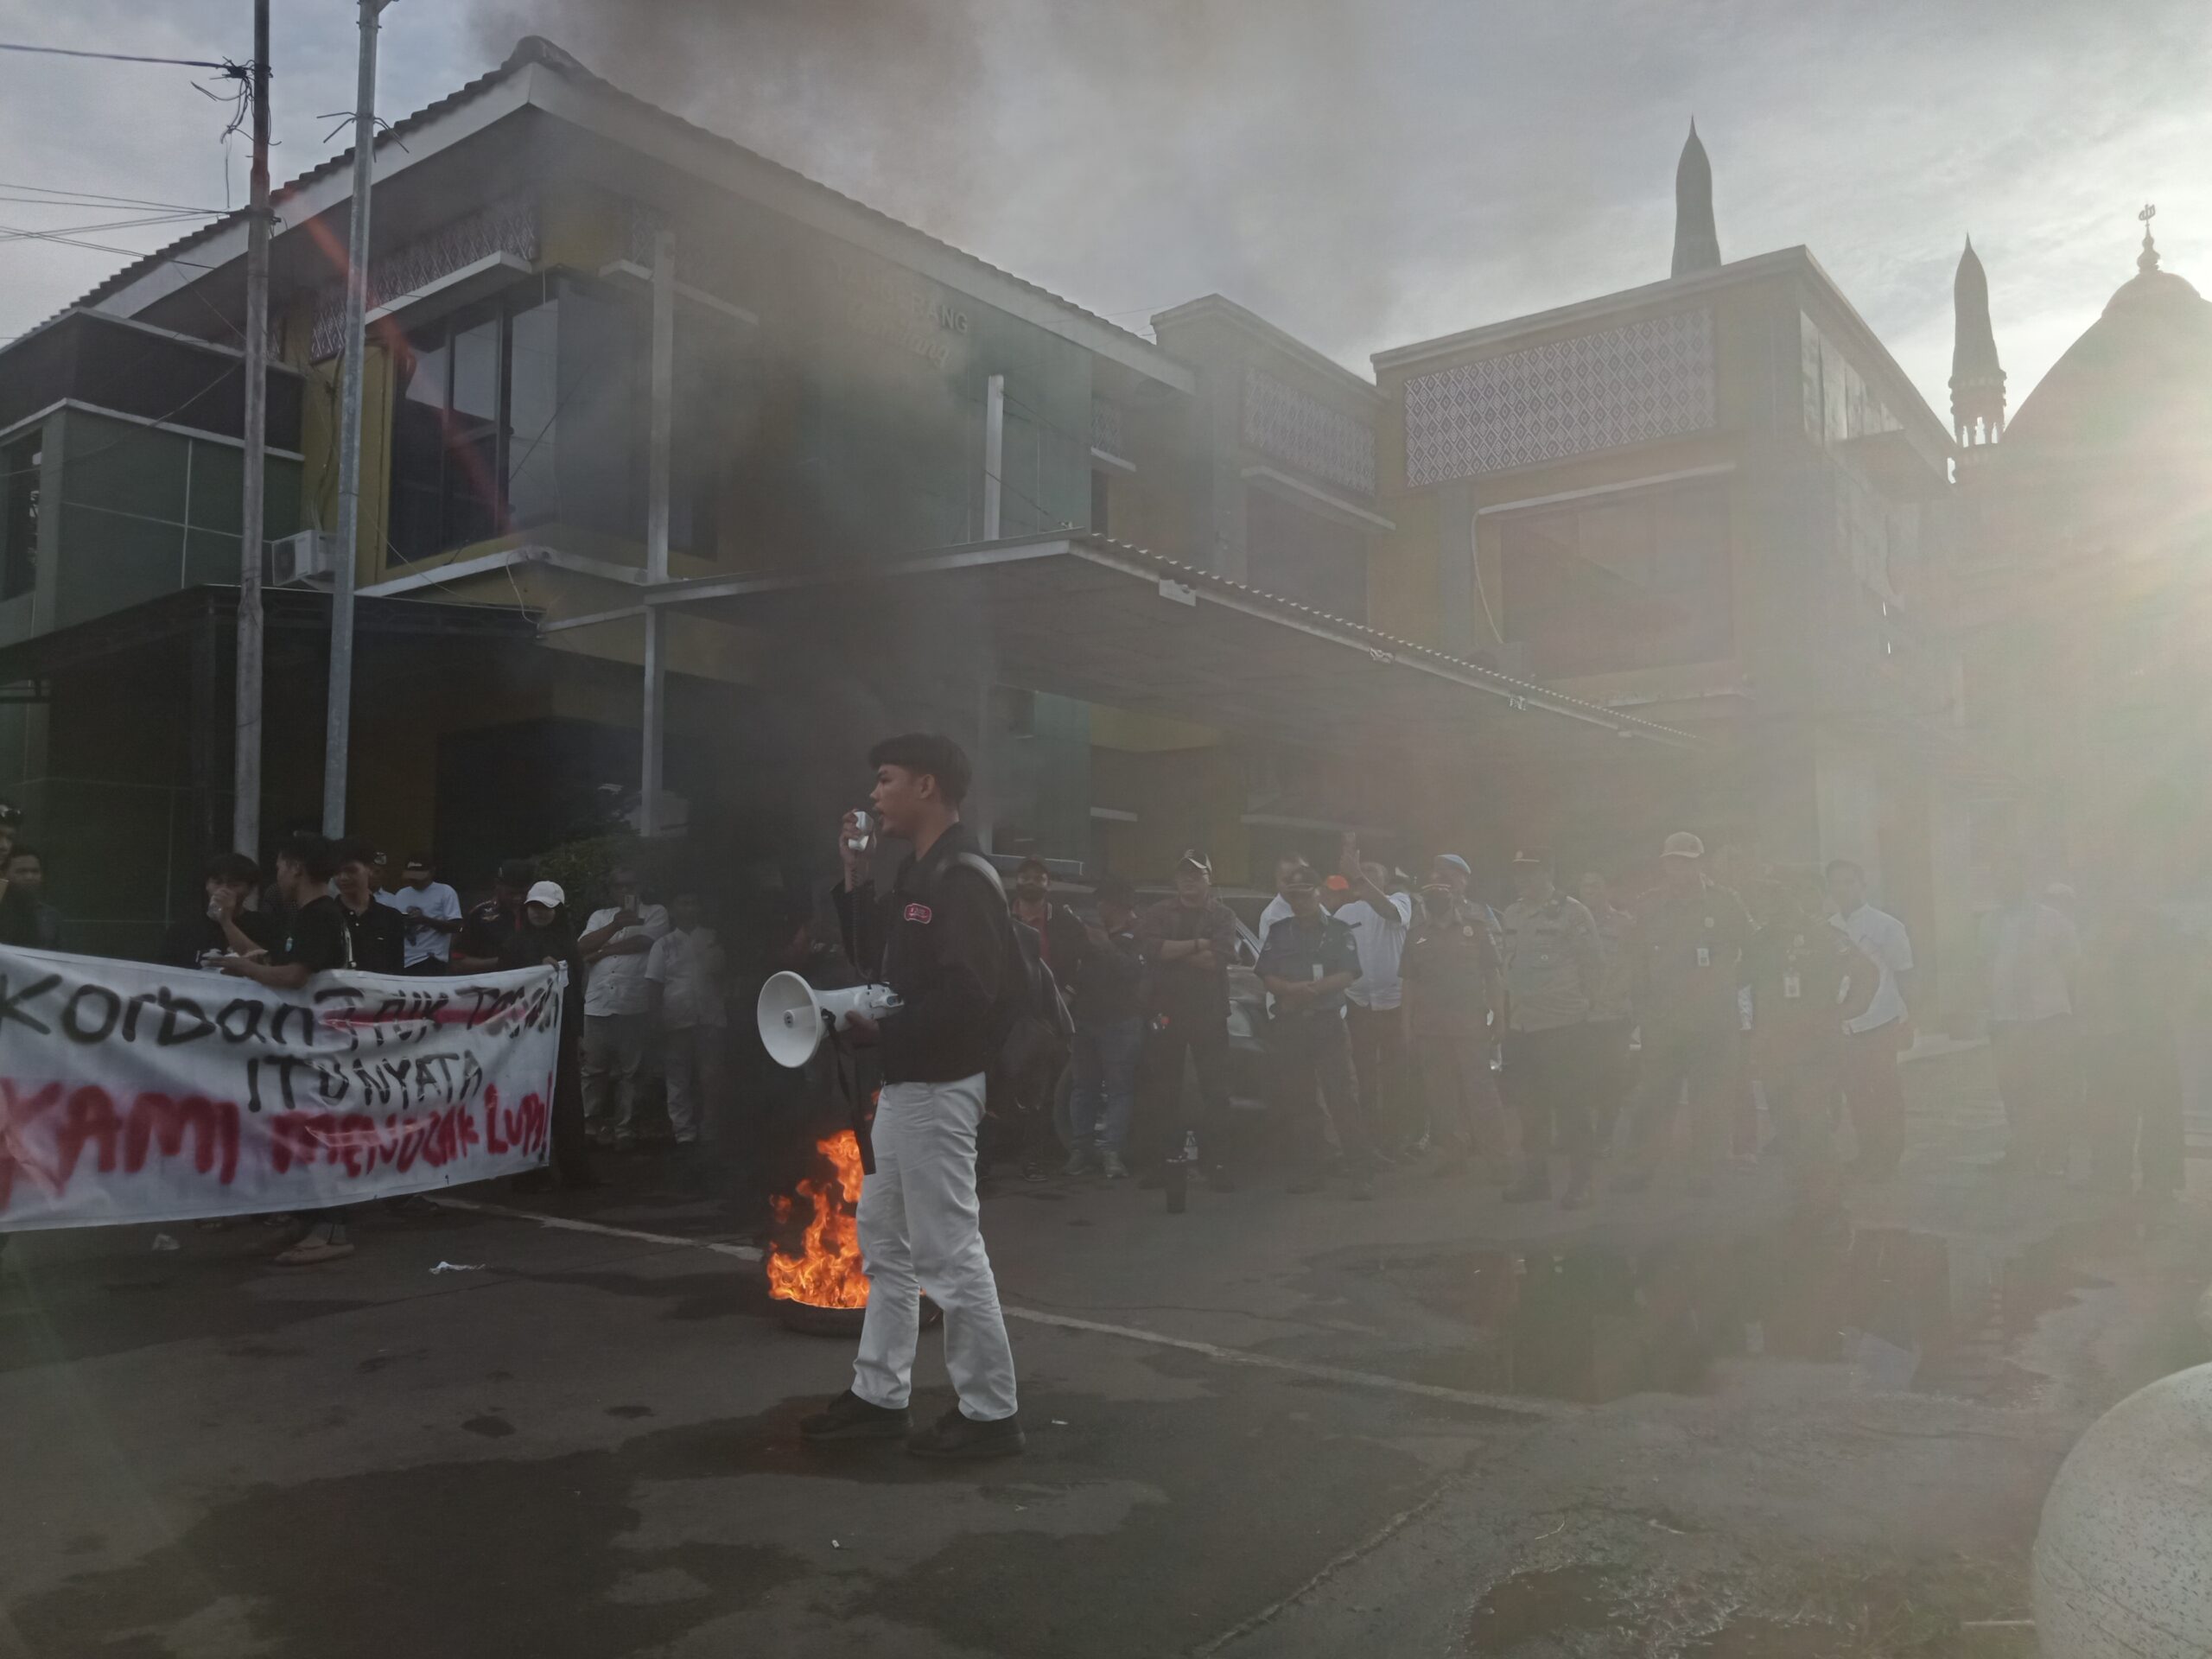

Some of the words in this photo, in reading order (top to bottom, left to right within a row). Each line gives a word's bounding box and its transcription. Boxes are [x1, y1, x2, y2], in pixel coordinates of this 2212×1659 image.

[247, 1051, 350, 1113] ITU
[352, 1049, 484, 1109] NYATA
[0, 1077, 240, 1211] KAMI
